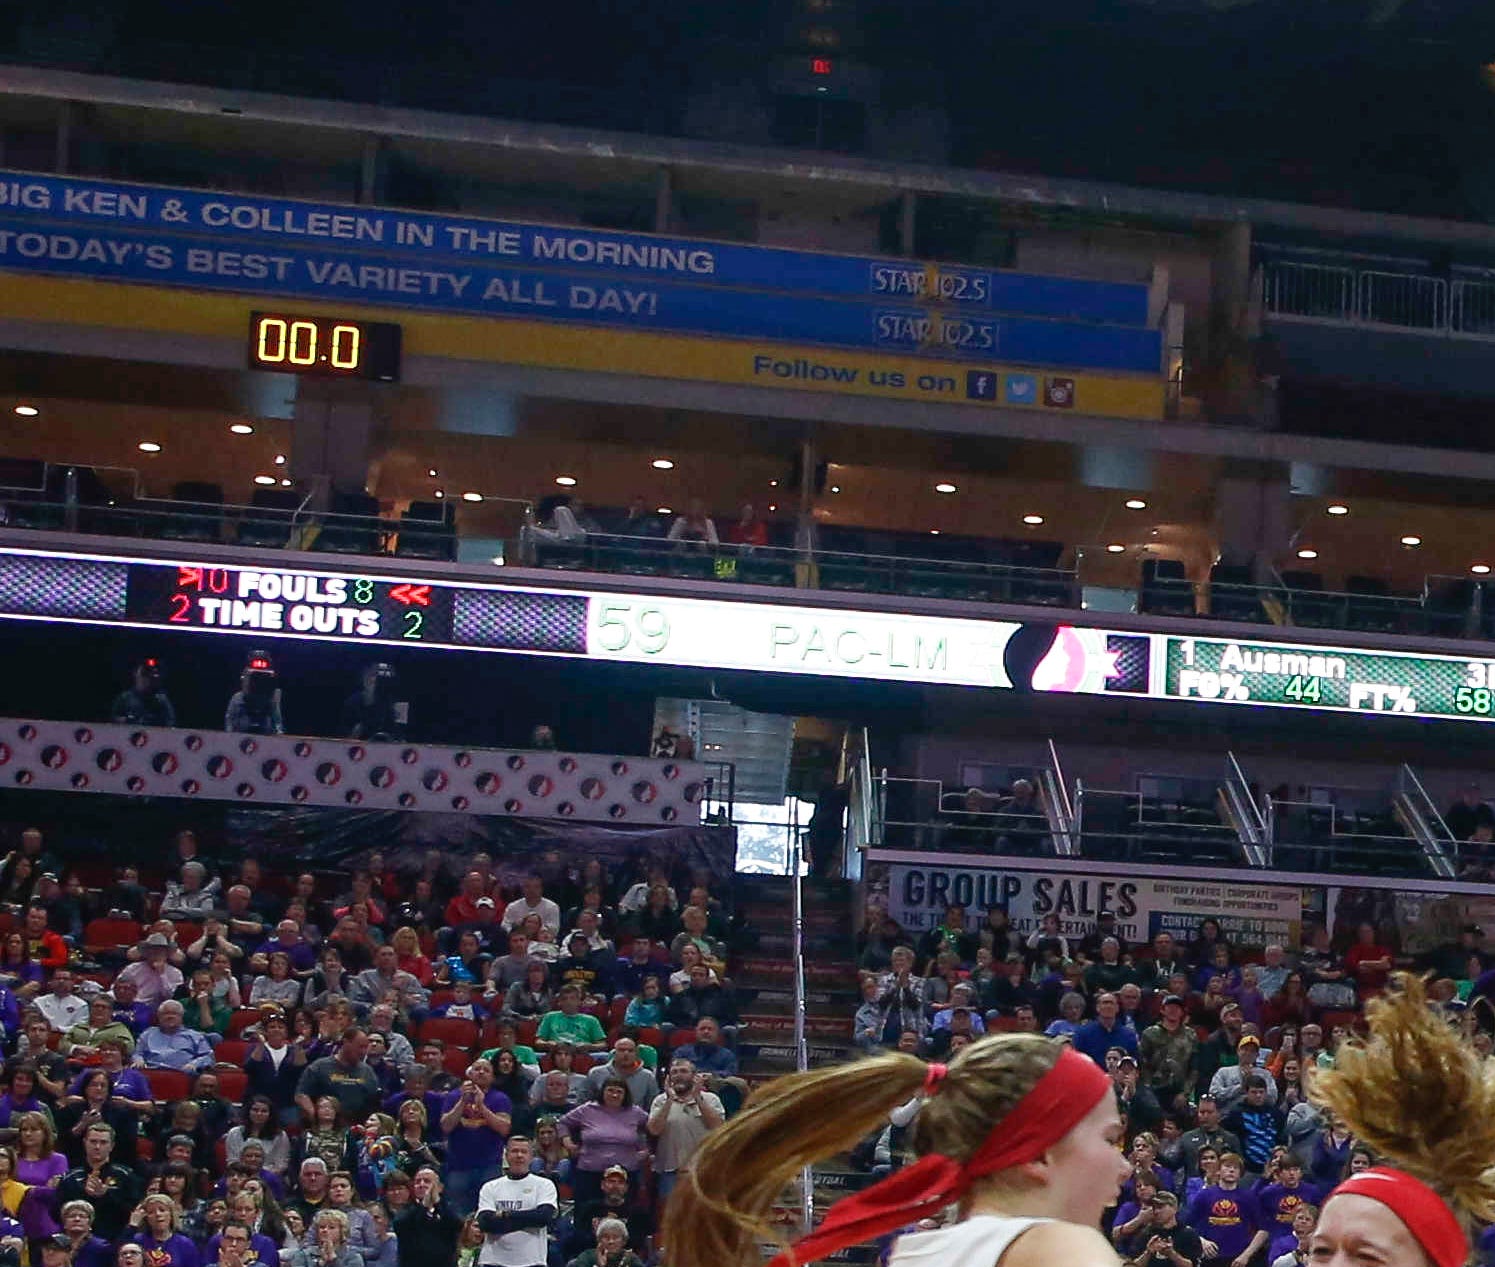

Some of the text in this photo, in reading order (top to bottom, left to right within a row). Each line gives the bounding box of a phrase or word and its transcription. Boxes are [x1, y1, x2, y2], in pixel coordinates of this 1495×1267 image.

[64, 188, 147, 218] KEN
[160, 200, 189, 223] &
[202, 202, 383, 242] COLLEEN
[396, 221, 433, 247] IN
[446, 226, 521, 255] THE
[533, 235, 715, 274] MORNING
[0, 230, 657, 316] TODAY'S BEST VARIETY ALL DAY!
[874, 266, 926, 294] STAR
[258, 317, 360, 369] 00.0
[754, 355, 859, 386] Follow
[869, 370, 906, 388] us
[917, 374, 957, 393] on
[238, 571, 348, 604] FOULS
[354, 578, 374, 604] 8
[169, 594, 423, 639] 2 TIME OUTS 2
[598, 604, 672, 655] 59
[770, 622, 948, 671] PAC-LM
[1219, 644, 1346, 680] Ausman
[1285, 676, 1321, 703] 44
[1348, 683, 1416, 713] FT%
[1455, 687, 1492, 715] 58
[903, 869, 1138, 918] GROUP SALES
[903, 911, 927, 926] THE
